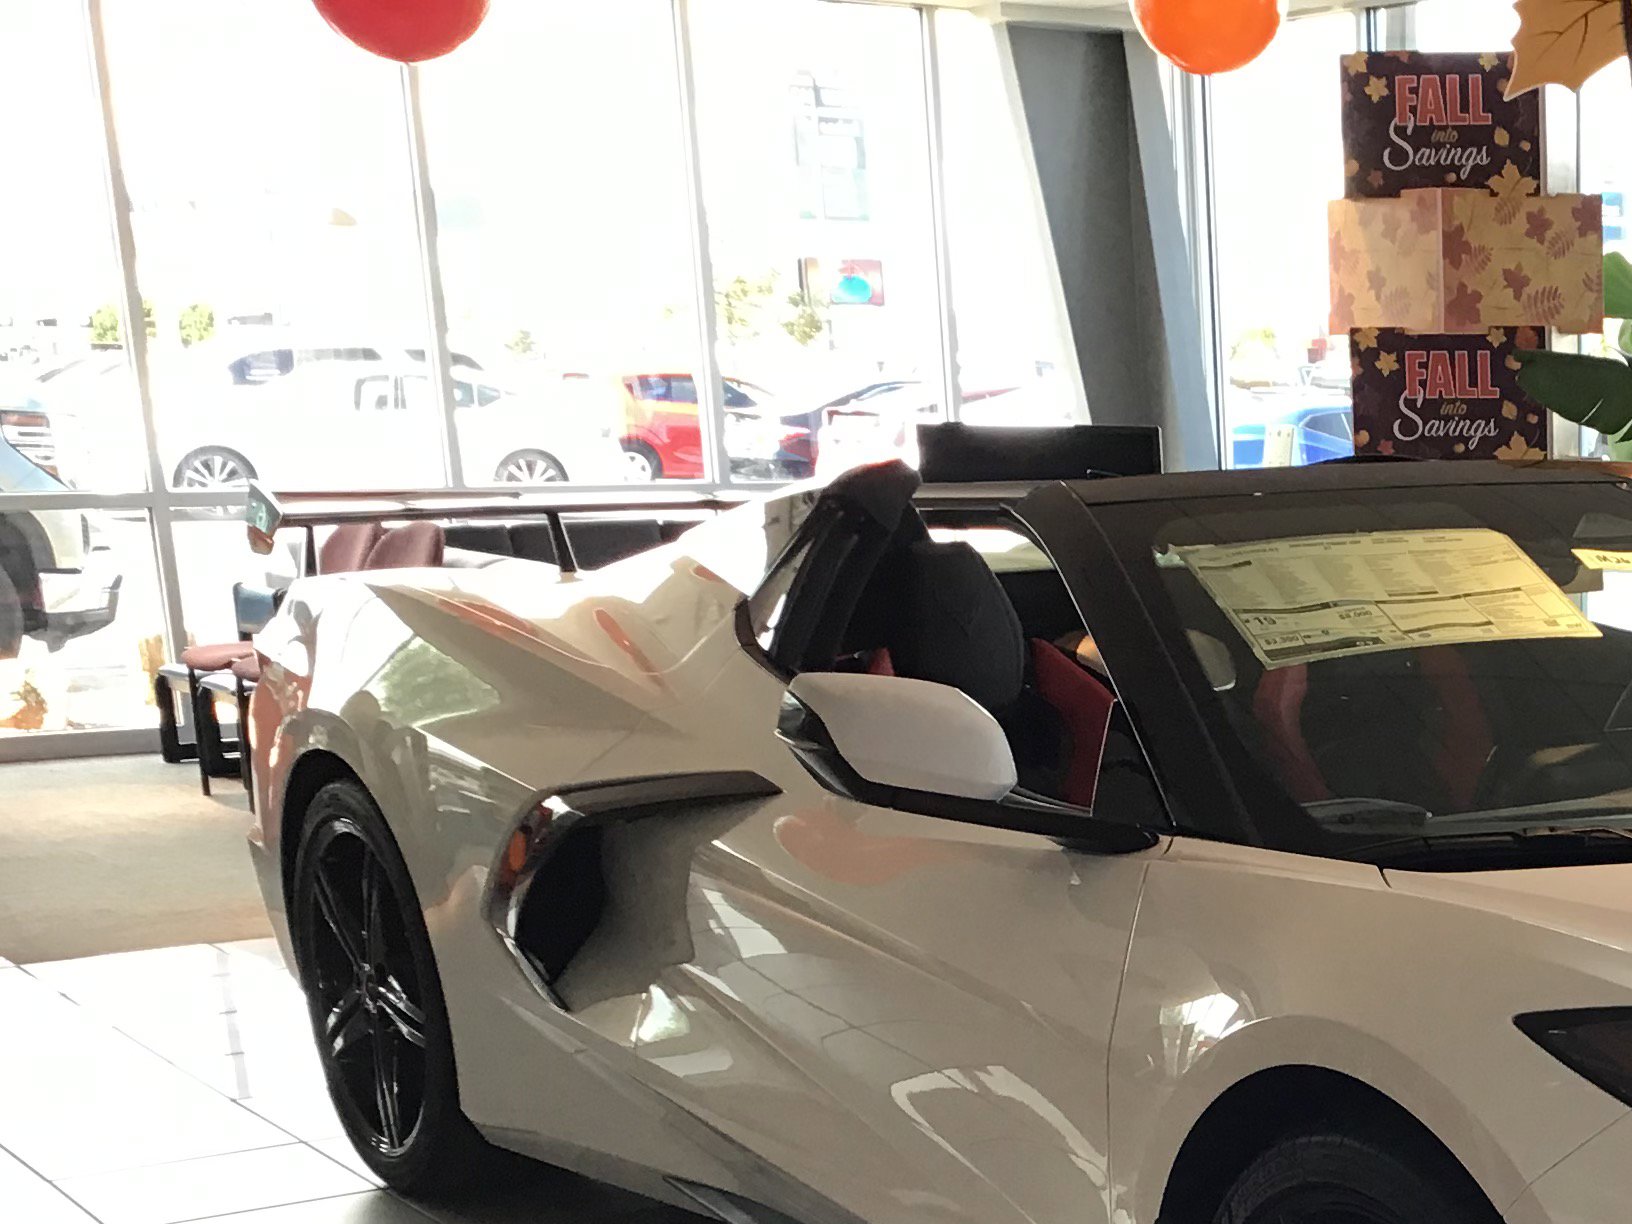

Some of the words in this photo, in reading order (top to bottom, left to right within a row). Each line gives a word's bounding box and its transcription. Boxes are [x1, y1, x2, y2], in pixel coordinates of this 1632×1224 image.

[1394, 73, 1493, 126] FALL
[1383, 110, 1492, 180] Savings
[1430, 127, 1460, 143] into
[1404, 349, 1501, 399] FALL
[1393, 384, 1499, 451] Savings
[1439, 401, 1468, 416] into
